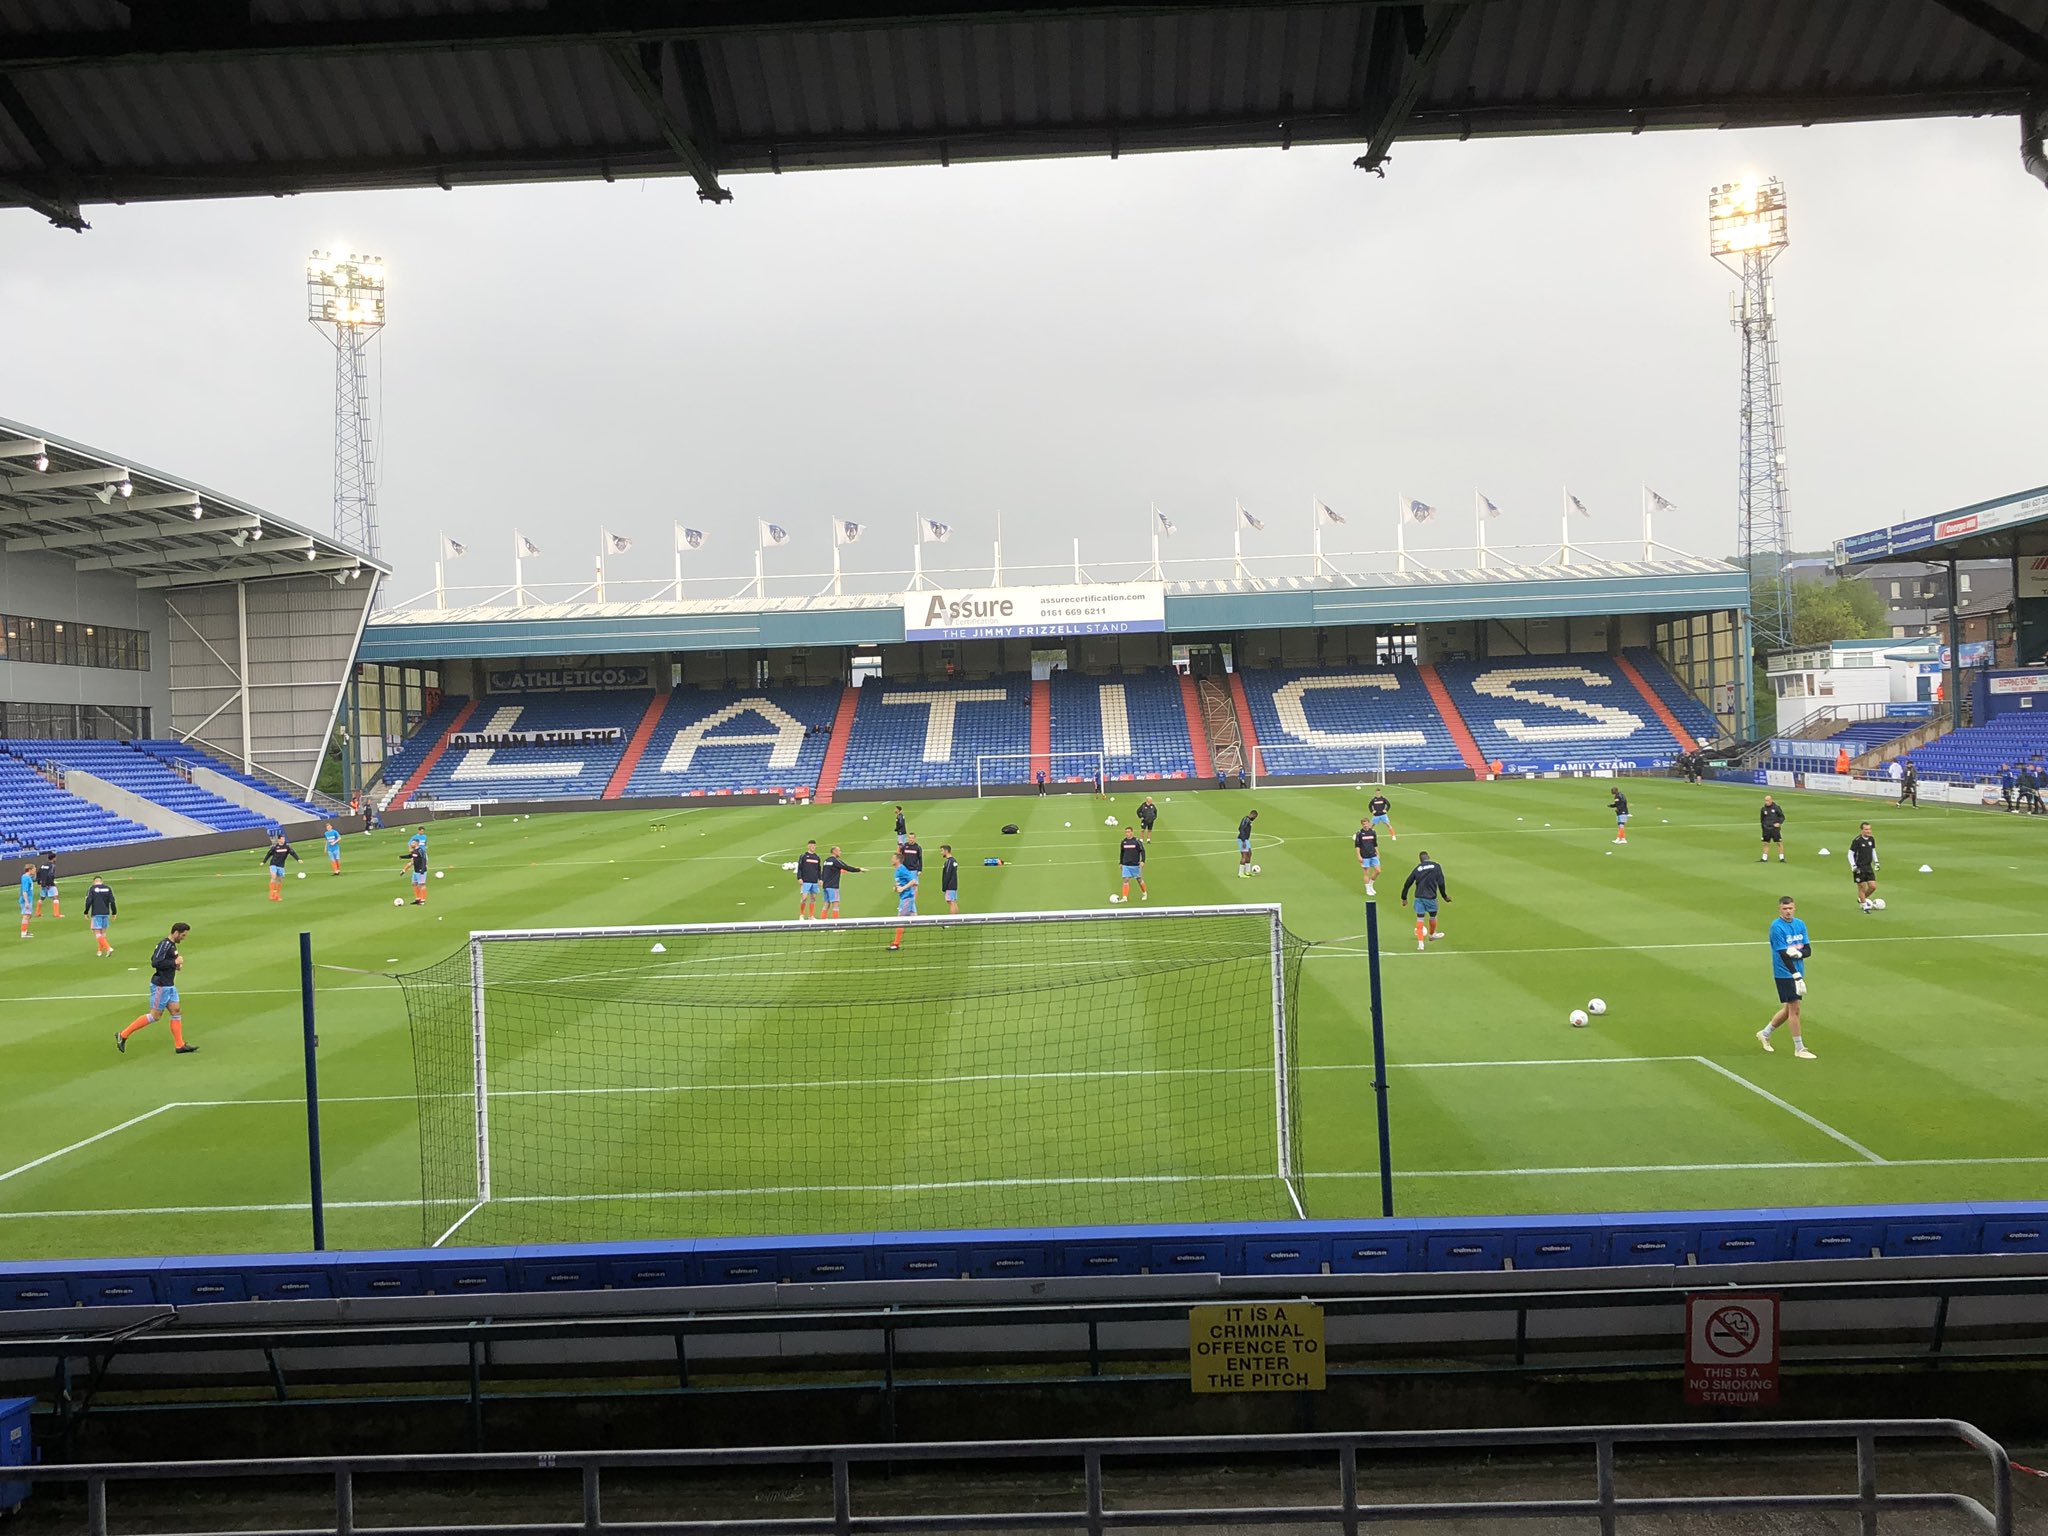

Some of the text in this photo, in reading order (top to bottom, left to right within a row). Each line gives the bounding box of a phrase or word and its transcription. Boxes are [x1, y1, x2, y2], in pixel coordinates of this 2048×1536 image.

[1040, 593, 1146, 605] assurecertification.com
[924, 595, 1014, 628] Assure
[1040, 607, 1106, 618] 0161 669 6211
[942, 622, 1129, 638] THE JIMMY FRIZZELL STAND
[511, 669, 626, 688] ATHLETICOS
[454, 730, 617, 750] OLDHAM ATHLETIC
[1553, 762, 1595, 771] FAMILY
[1598, 761, 1637, 770] STAND
[1226, 1307, 1287, 1322] IT IS A
[1209, 1324, 1304, 1339] CRIMINAL
[1197, 1339, 1318, 1355] OFFENCE TO
[1227, 1357, 1289, 1371] ENTER
[1704, 1367, 1760, 1378] THIS IS A
[1208, 1373, 1308, 1388] THE PITCH
[1690, 1379, 1773, 1390] NO SMOKING
[1703, 1392, 1759, 1402] STADIUM
